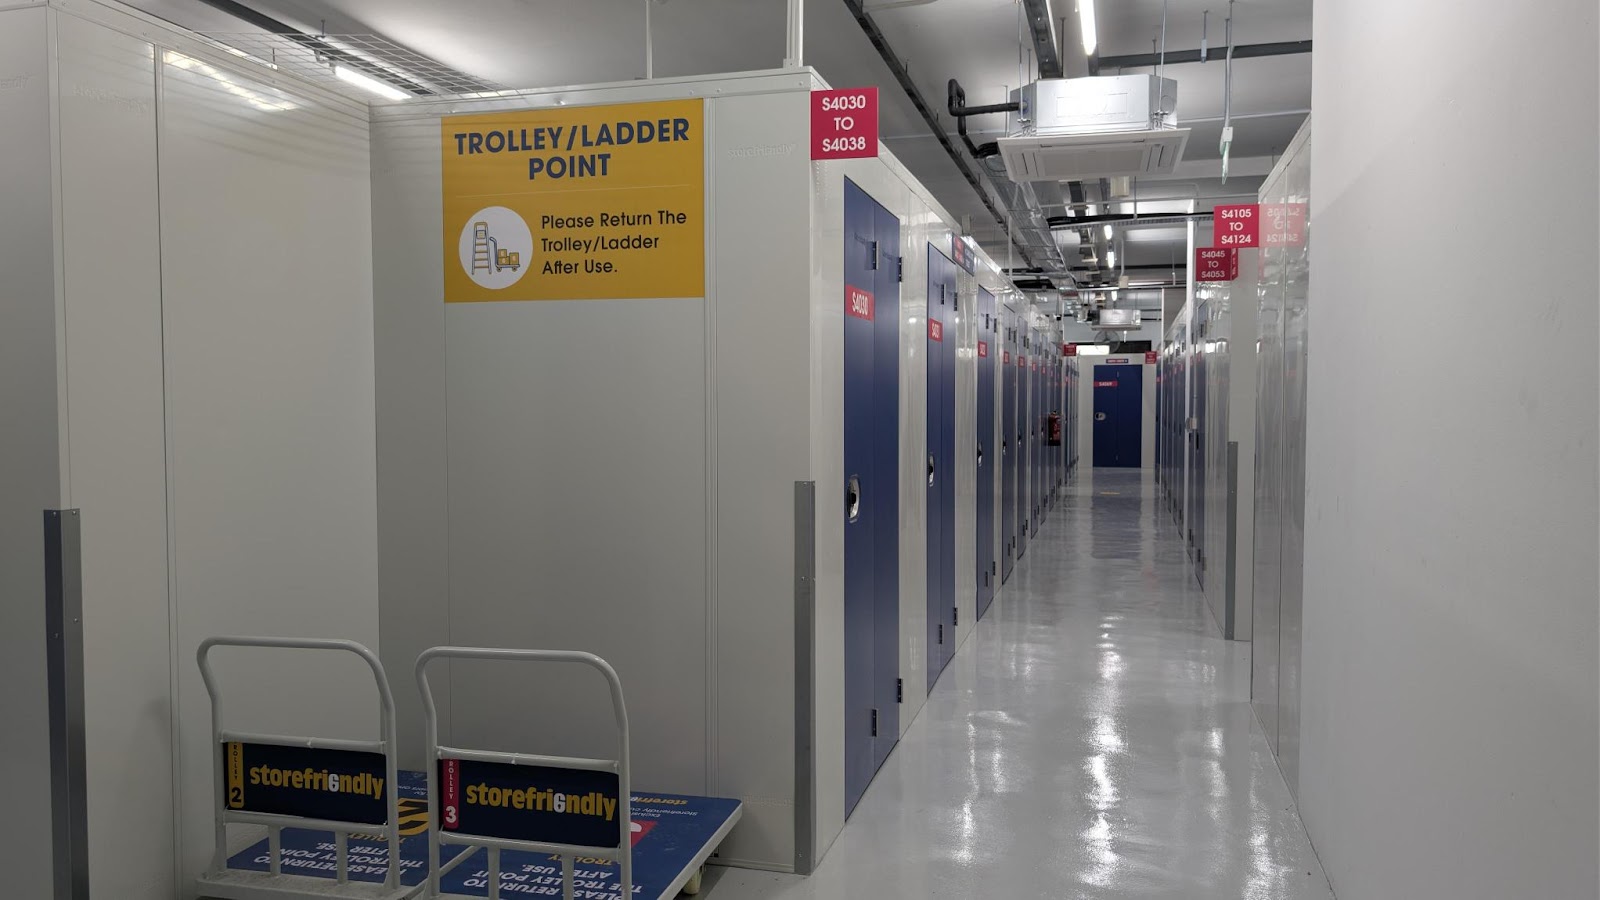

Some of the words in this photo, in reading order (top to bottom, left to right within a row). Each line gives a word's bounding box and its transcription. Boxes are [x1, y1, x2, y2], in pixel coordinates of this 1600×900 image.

[821, 95, 867, 112] S4030
[833, 116, 854, 131] TO
[454, 118, 690, 155] TROLLEY/LADDER
[821, 136, 867, 153] S4038
[528, 153, 612, 180] POINT
[541, 211, 594, 230] Please
[600, 211, 652, 227] Return
[658, 210, 687, 225] The
[1221, 208, 1252, 219] S4105
[1229, 221, 1243, 231] TO
[541, 234, 659, 254] Trolley/Ladder
[1221, 234, 1252, 244] S4124
[1201, 250, 1226, 259] S4045
[542, 259, 580, 275] After
[584, 259, 618, 274] Use.
[1207, 260, 1219, 268] TO
[1201, 270, 1226, 279] S4053
[851, 291, 869, 316] S4030
[447, 759, 455, 800] ROLLEY
[231, 786, 242, 803] 2
[445, 805, 457, 824] 3
[521, 864, 556, 874] USE.
[463, 878, 488, 888] TO
